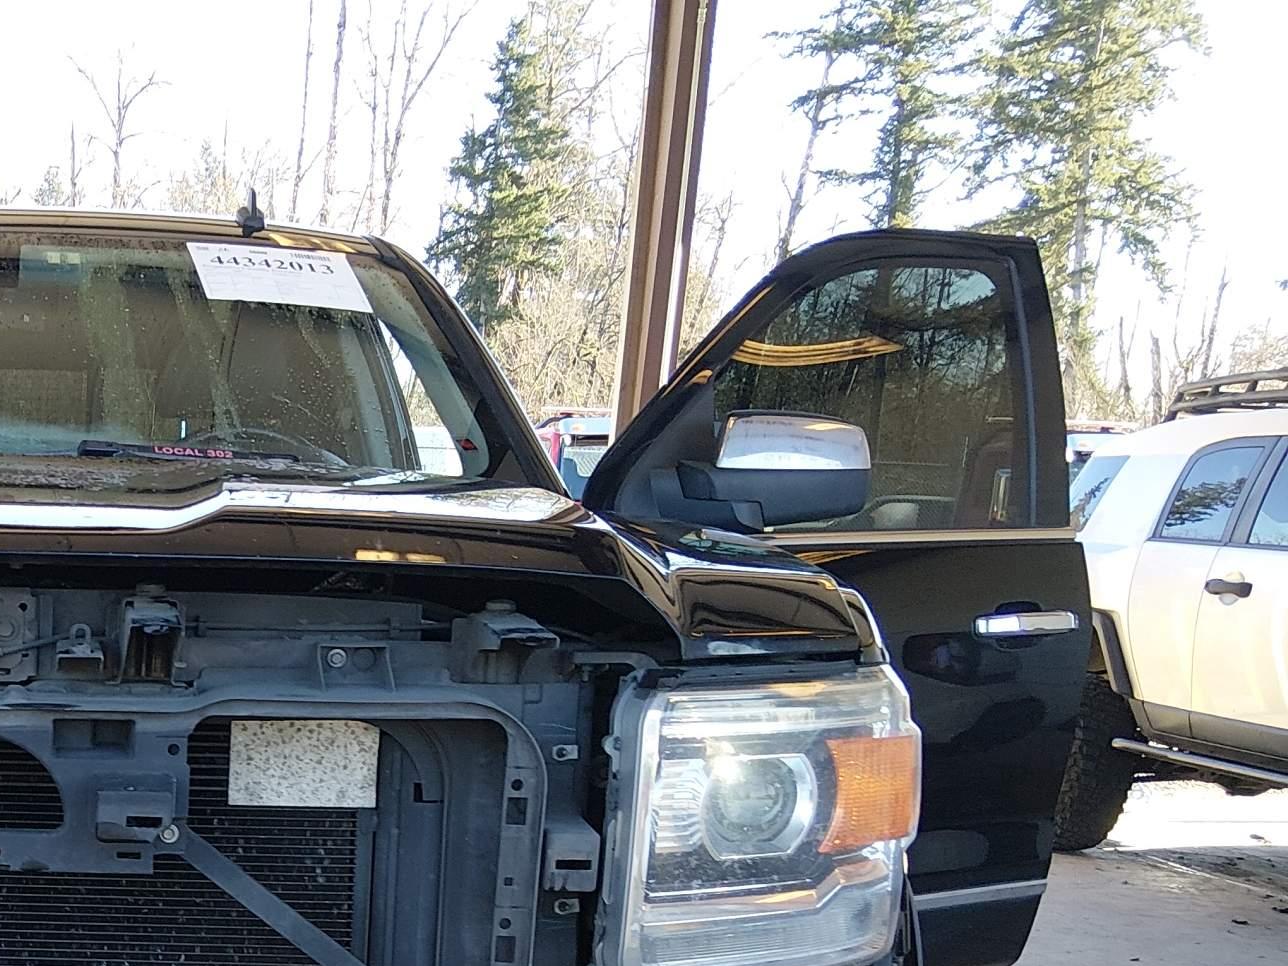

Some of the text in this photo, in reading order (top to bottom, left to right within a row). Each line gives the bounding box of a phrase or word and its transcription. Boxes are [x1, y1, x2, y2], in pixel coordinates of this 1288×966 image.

[210, 255, 335, 275] 44342013
[154, 446, 233, 458] LOCAL 302
